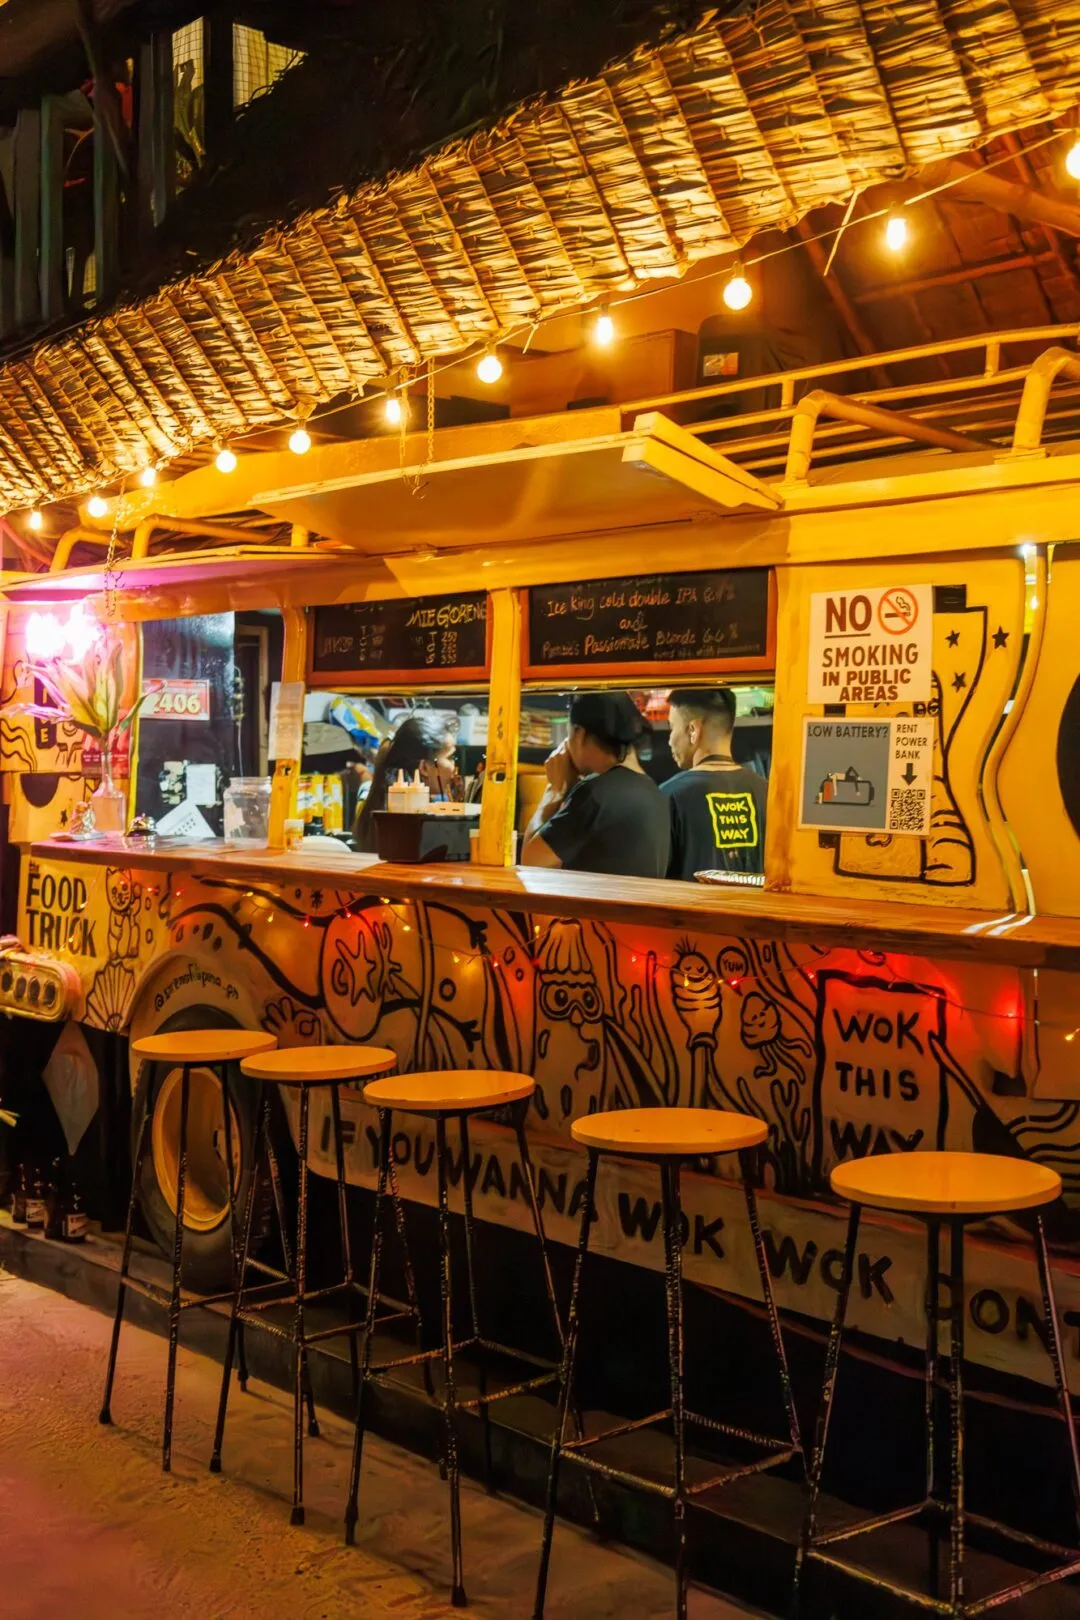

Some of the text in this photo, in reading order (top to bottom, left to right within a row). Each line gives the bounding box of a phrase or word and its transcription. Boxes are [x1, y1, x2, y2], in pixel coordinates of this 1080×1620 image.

[599, 592, 625, 609] cold
[629, 591, 671, 608] double
[675, 588, 698, 604] IPA
[406, 608, 436, 628] MIE
[825, 594, 872, 633] NO
[822, 642, 918, 669] SMOKING
[822, 668, 911, 687] IN PUBLIC
[839, 685, 899, 702] AREAS
[807, 725, 890, 739] LOW BATTERY?
[896, 724, 918, 734] RENT
[896, 737, 928, 747] POWER
[895, 750, 921, 760] BANK
[715, 800, 748, 812] WOK
[719, 815, 747, 825] THIS
[720, 828, 749, 840] WAY
[26, 872, 88, 914] FOOD
[25, 909, 97, 958] TRUCK
[833, 1008, 924, 1056] WOK
[835, 1061, 920, 1101] THIS
[365, 1125, 435, 1176] YOU
